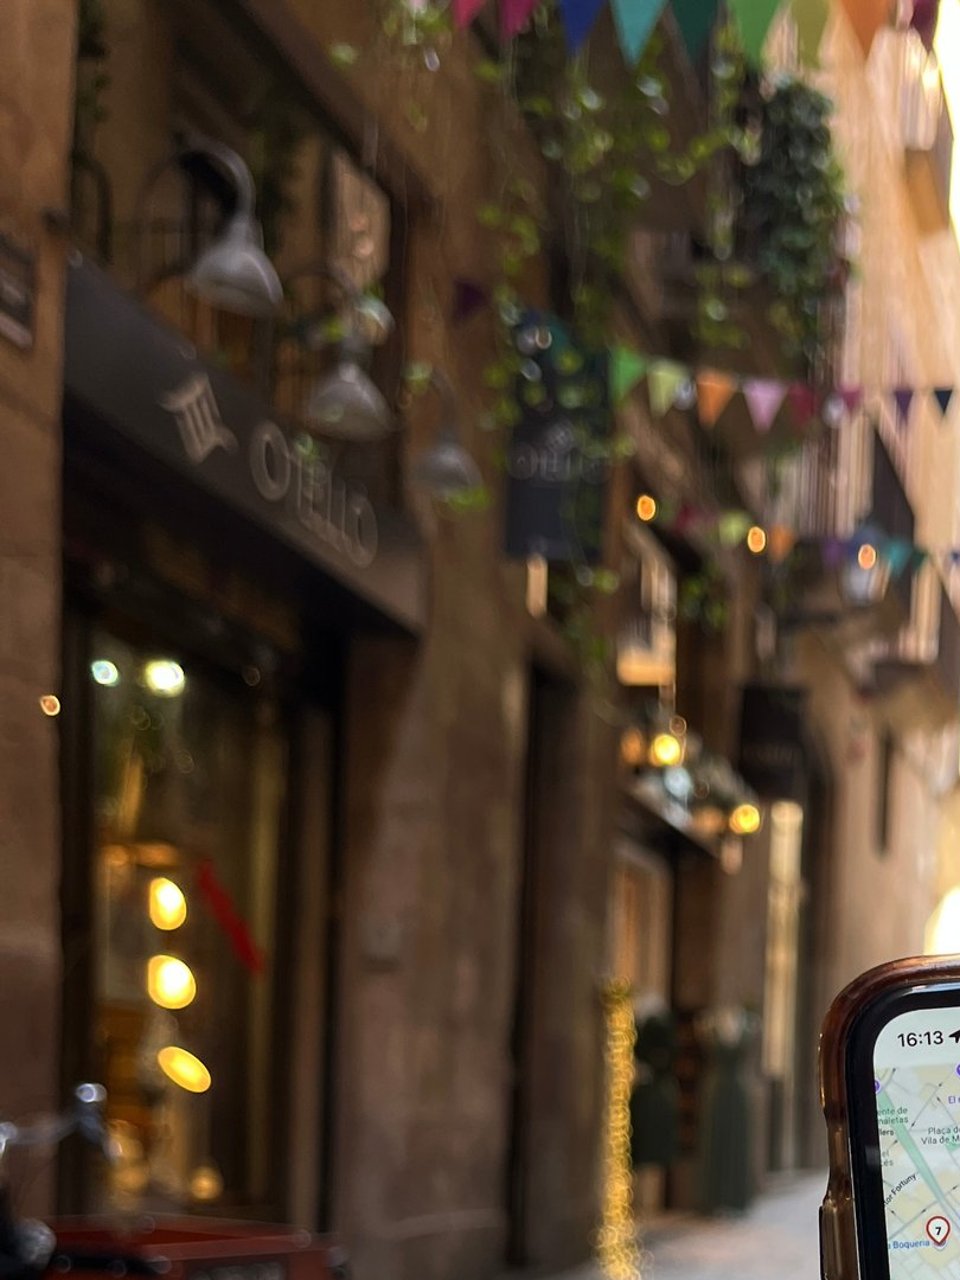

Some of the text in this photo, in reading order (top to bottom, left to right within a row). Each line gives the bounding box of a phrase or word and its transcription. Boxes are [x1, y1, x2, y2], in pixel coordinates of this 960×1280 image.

[897, 1030, 944, 1047] 16:13
[948, 1095, 956, 1104] El
[927, 1126, 951, 1136] Plaça
[921, 1137, 938, 1145] Vila
[940, 1135, 950, 1144] de
[935, 1226, 942, 1236] 7
